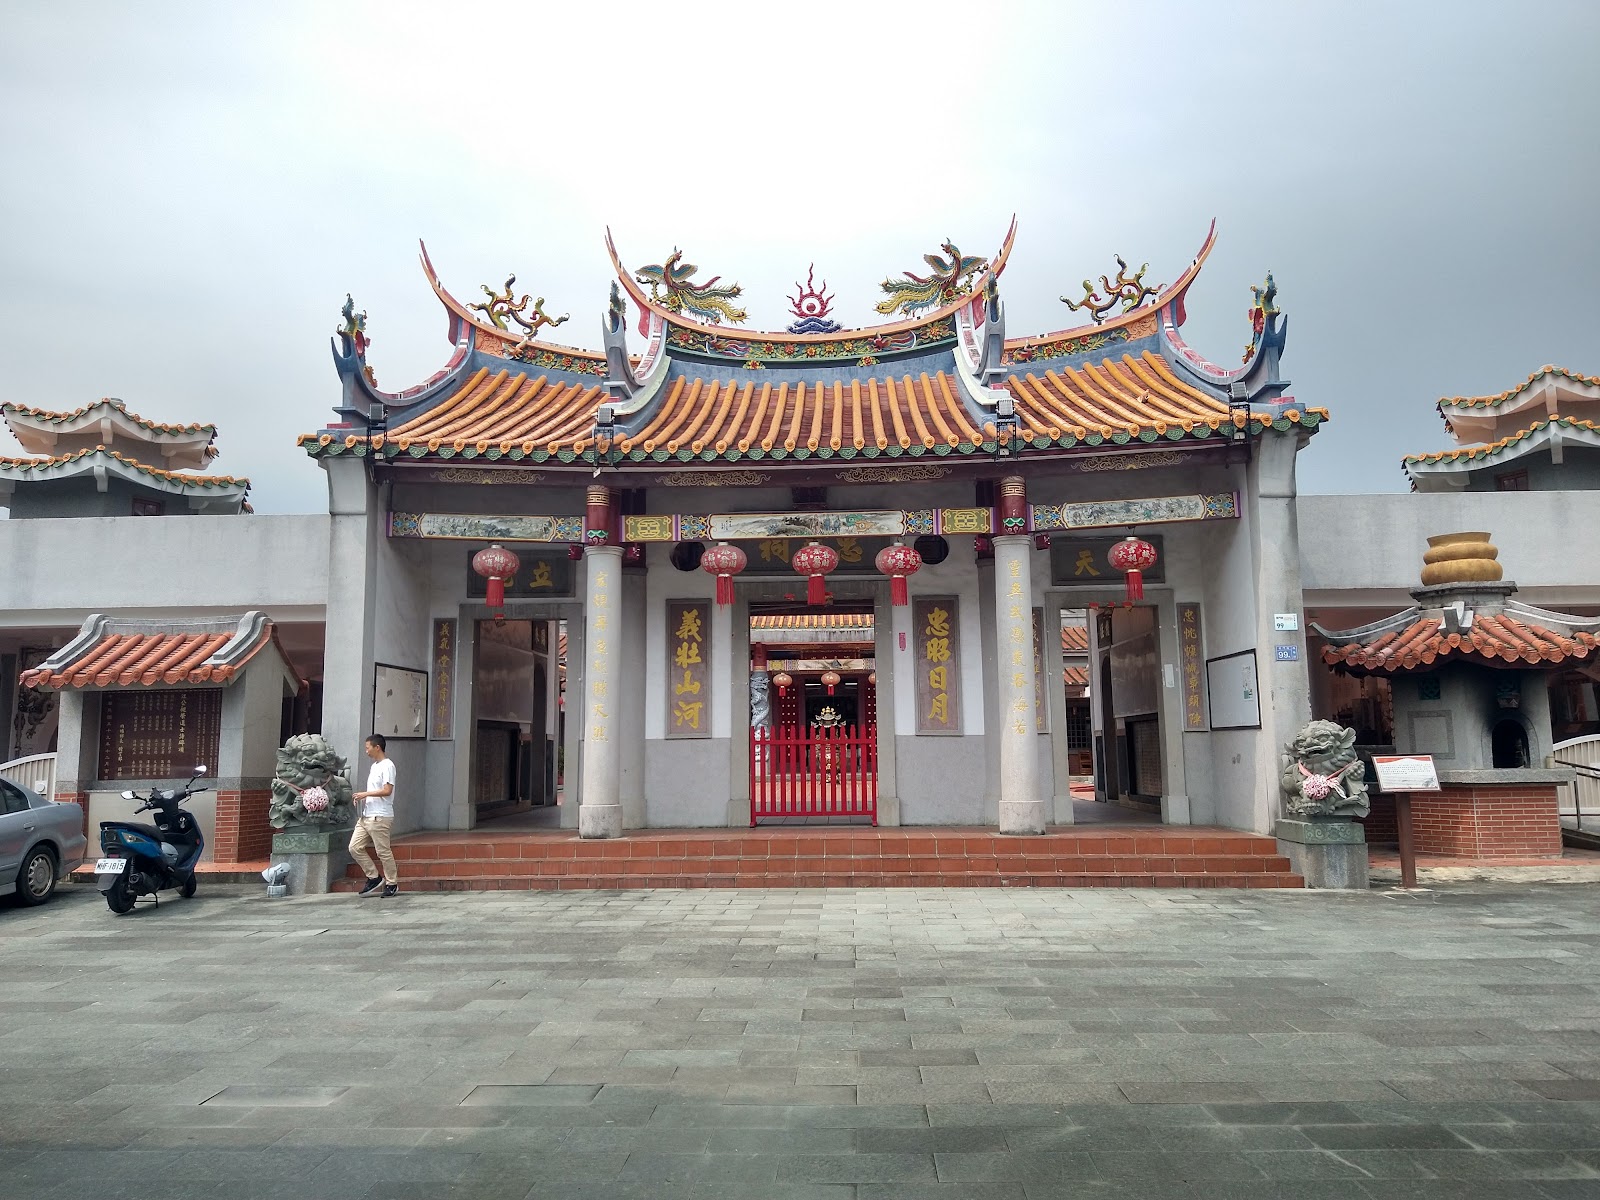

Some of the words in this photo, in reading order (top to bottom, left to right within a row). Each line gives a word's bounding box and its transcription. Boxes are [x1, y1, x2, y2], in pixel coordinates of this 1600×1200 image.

[674, 608, 703, 729] 義壯山河
[925, 607, 952, 724] 忠昭日月
